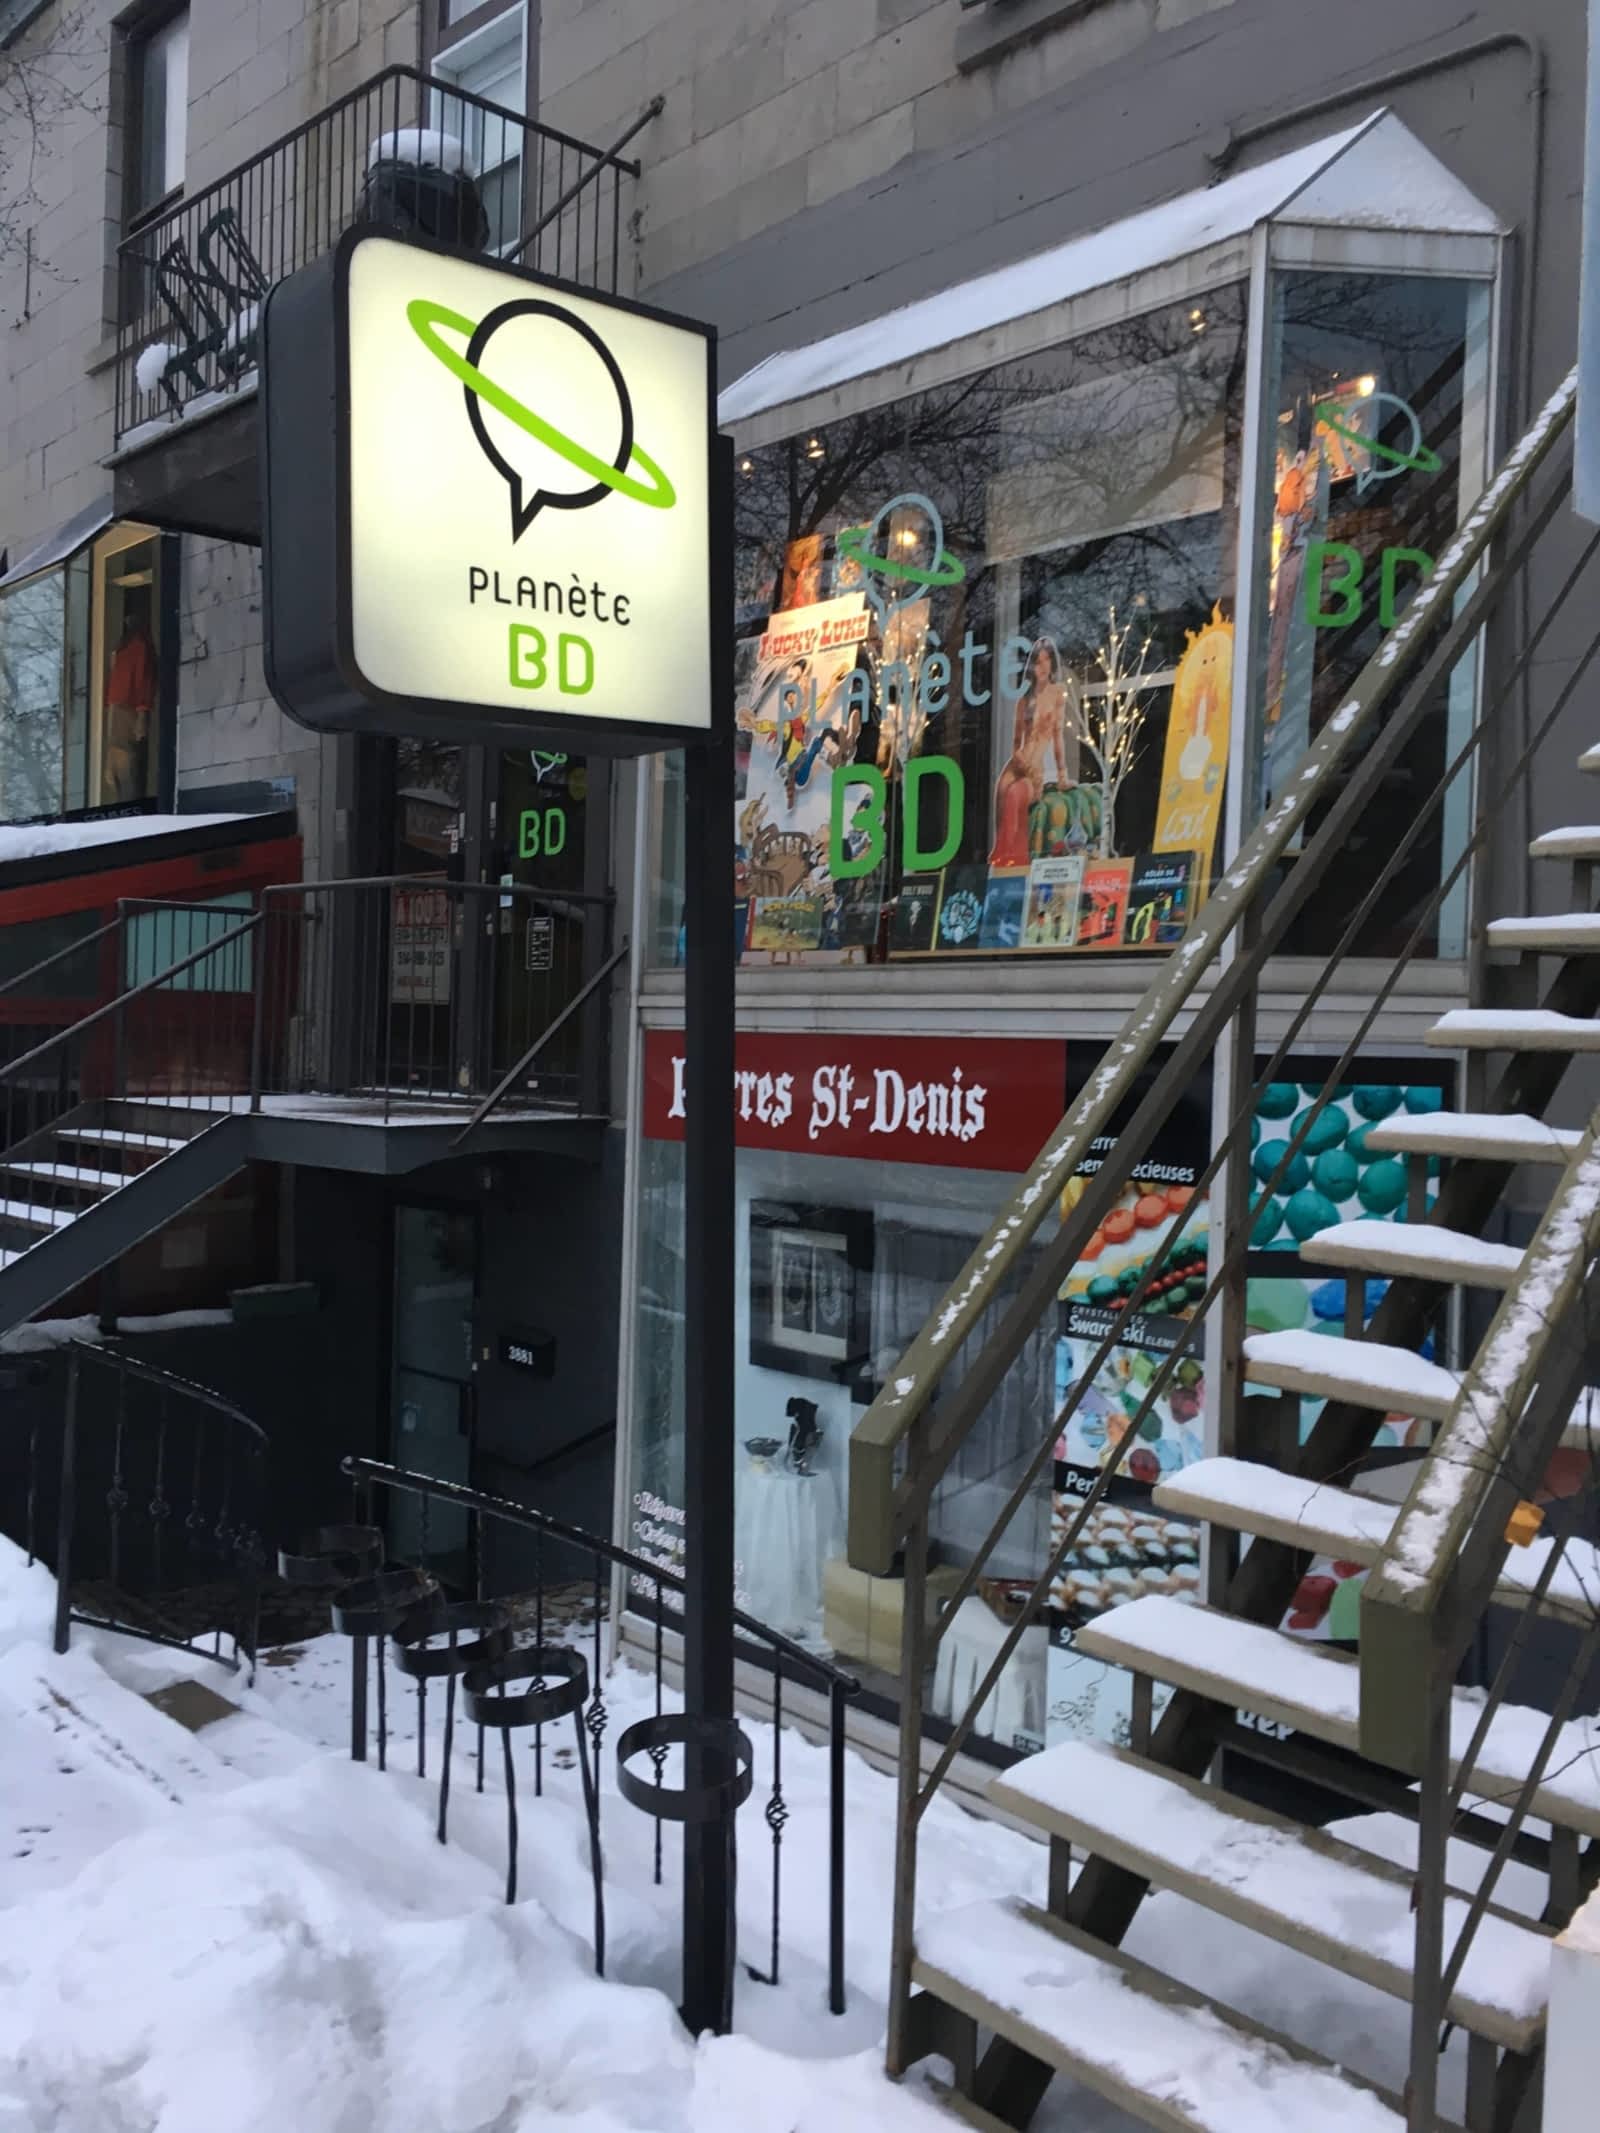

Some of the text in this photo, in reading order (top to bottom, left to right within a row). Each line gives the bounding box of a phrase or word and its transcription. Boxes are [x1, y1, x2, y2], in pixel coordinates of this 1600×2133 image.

[1304, 543, 1434, 628] BD
[509, 624, 594, 695] BD
[519, 807, 566, 859] BD
[830, 755, 965, 880] BD
[808, 1064, 987, 1142] St-Denis
